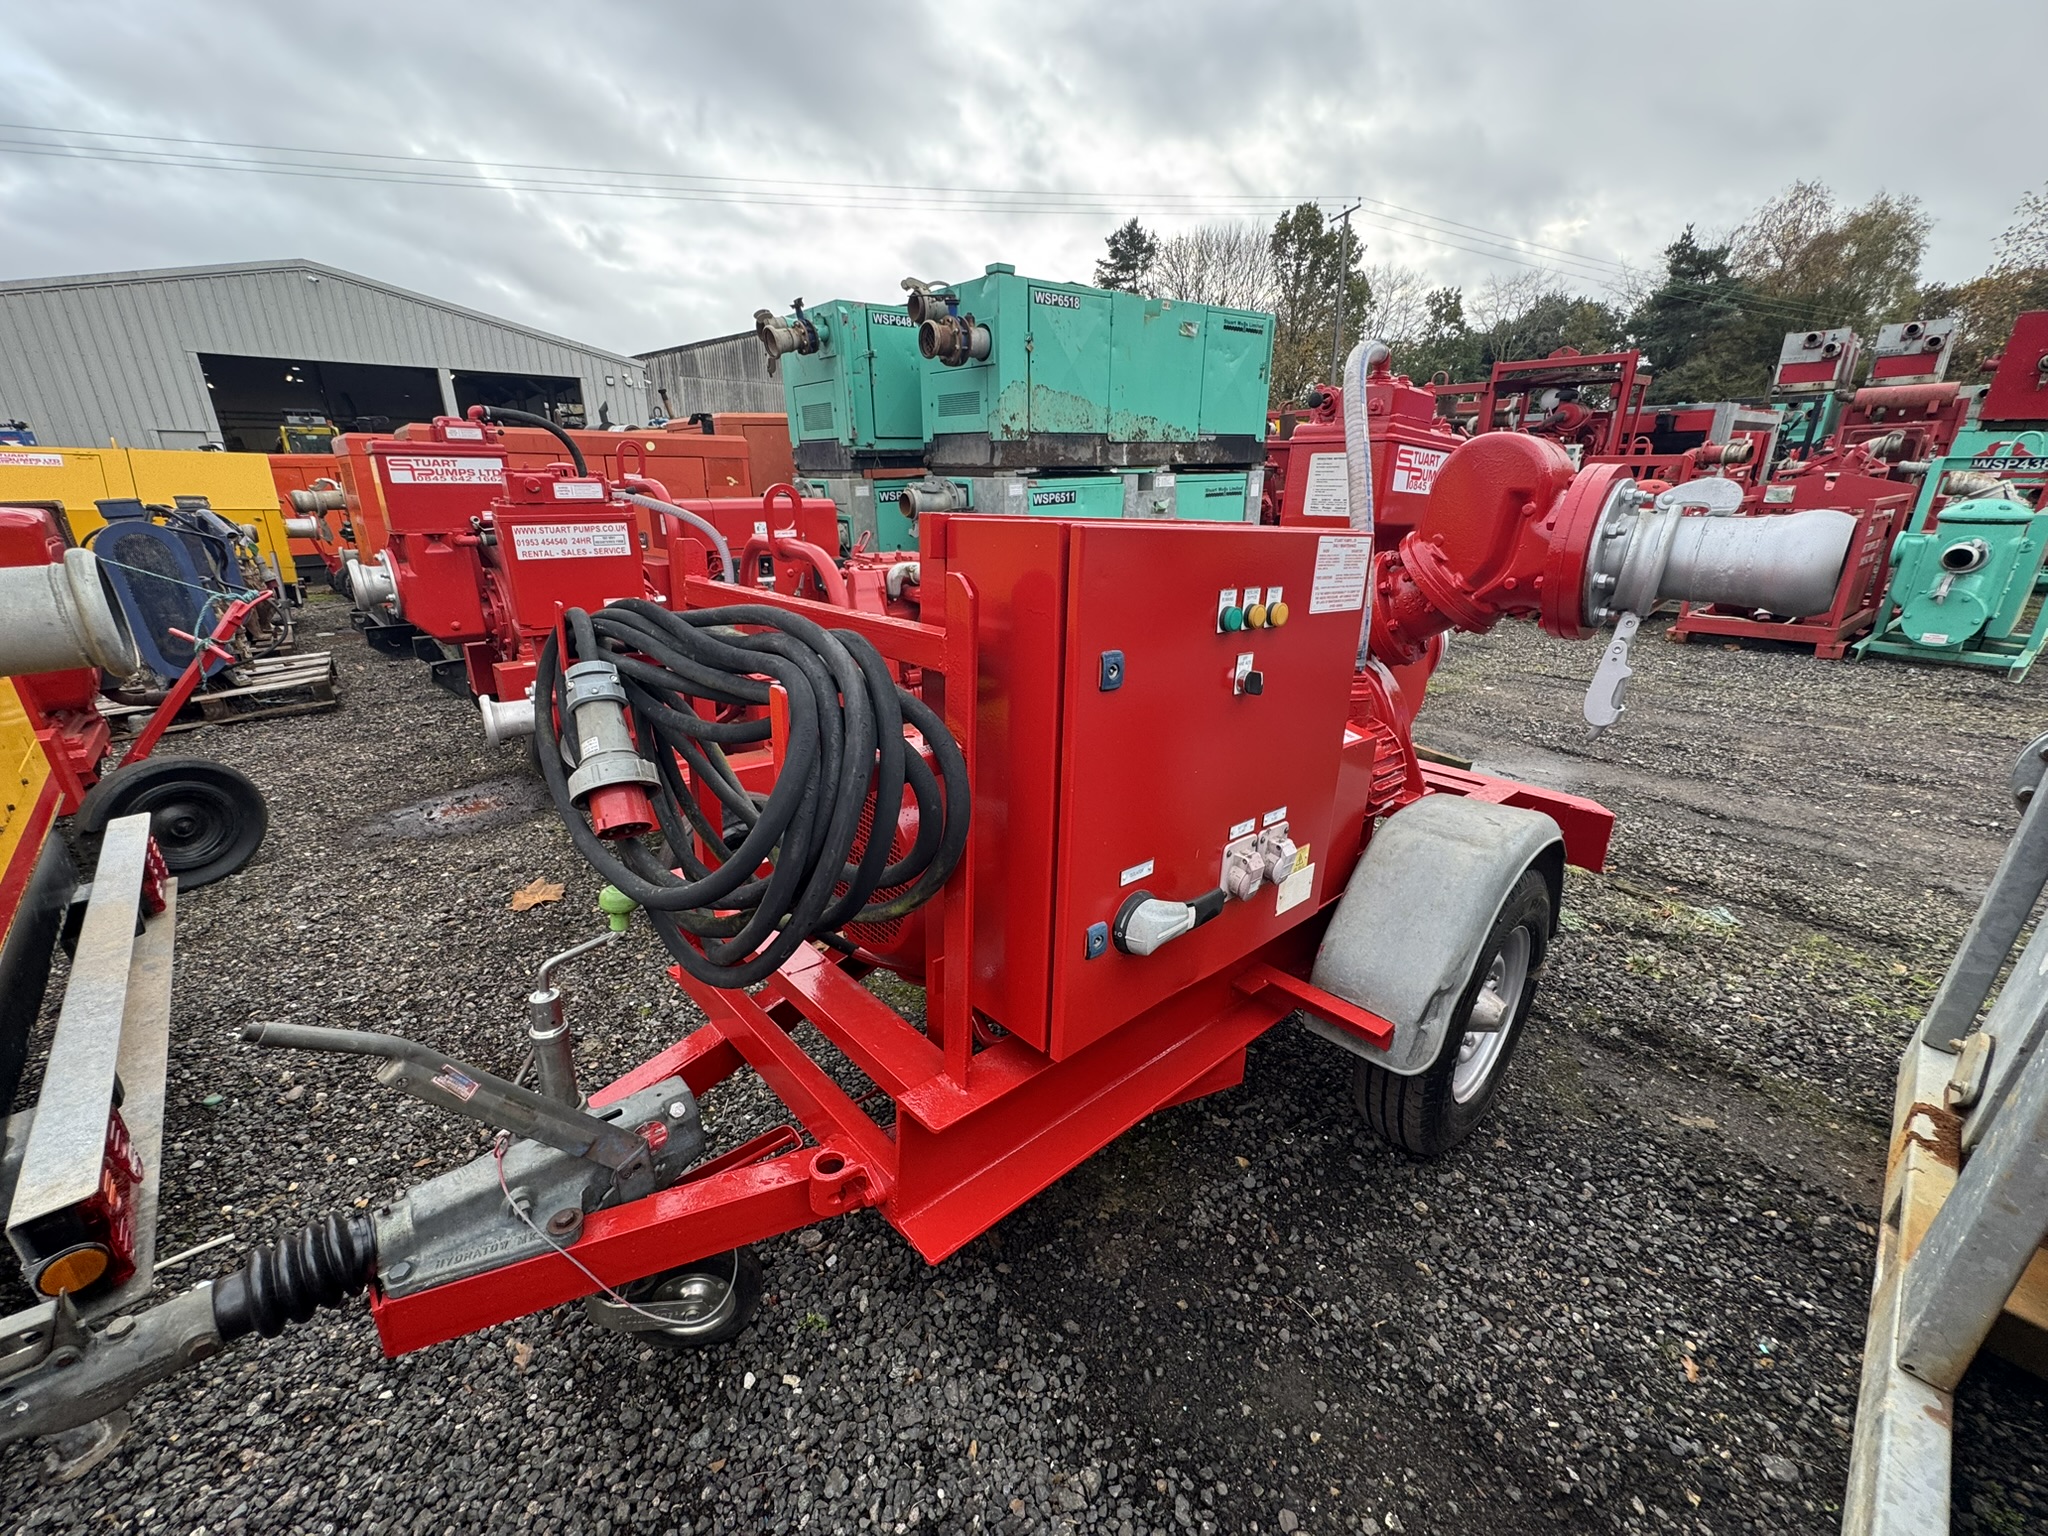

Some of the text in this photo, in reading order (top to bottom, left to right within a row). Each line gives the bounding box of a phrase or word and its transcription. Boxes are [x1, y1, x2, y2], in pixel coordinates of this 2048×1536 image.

[1034, 291, 1080, 309] WSP6518
[388, 459, 458, 467] STUART
[1398, 448, 1441, 468] STUART
[478, 468, 501, 477] LTD
[1408, 480, 1427, 491] 0845
[879, 491, 901, 502] WSP
[1033, 491, 1075, 506] WSP6511
[516, 538, 540, 547] 01953
[541, 537, 568, 546] 454540
[571, 536, 592, 545] 24HR
[521, 550, 555, 558] RENTAL
[561, 548, 588, 557] SALES
[593, 546, 626, 555] SERVICE
